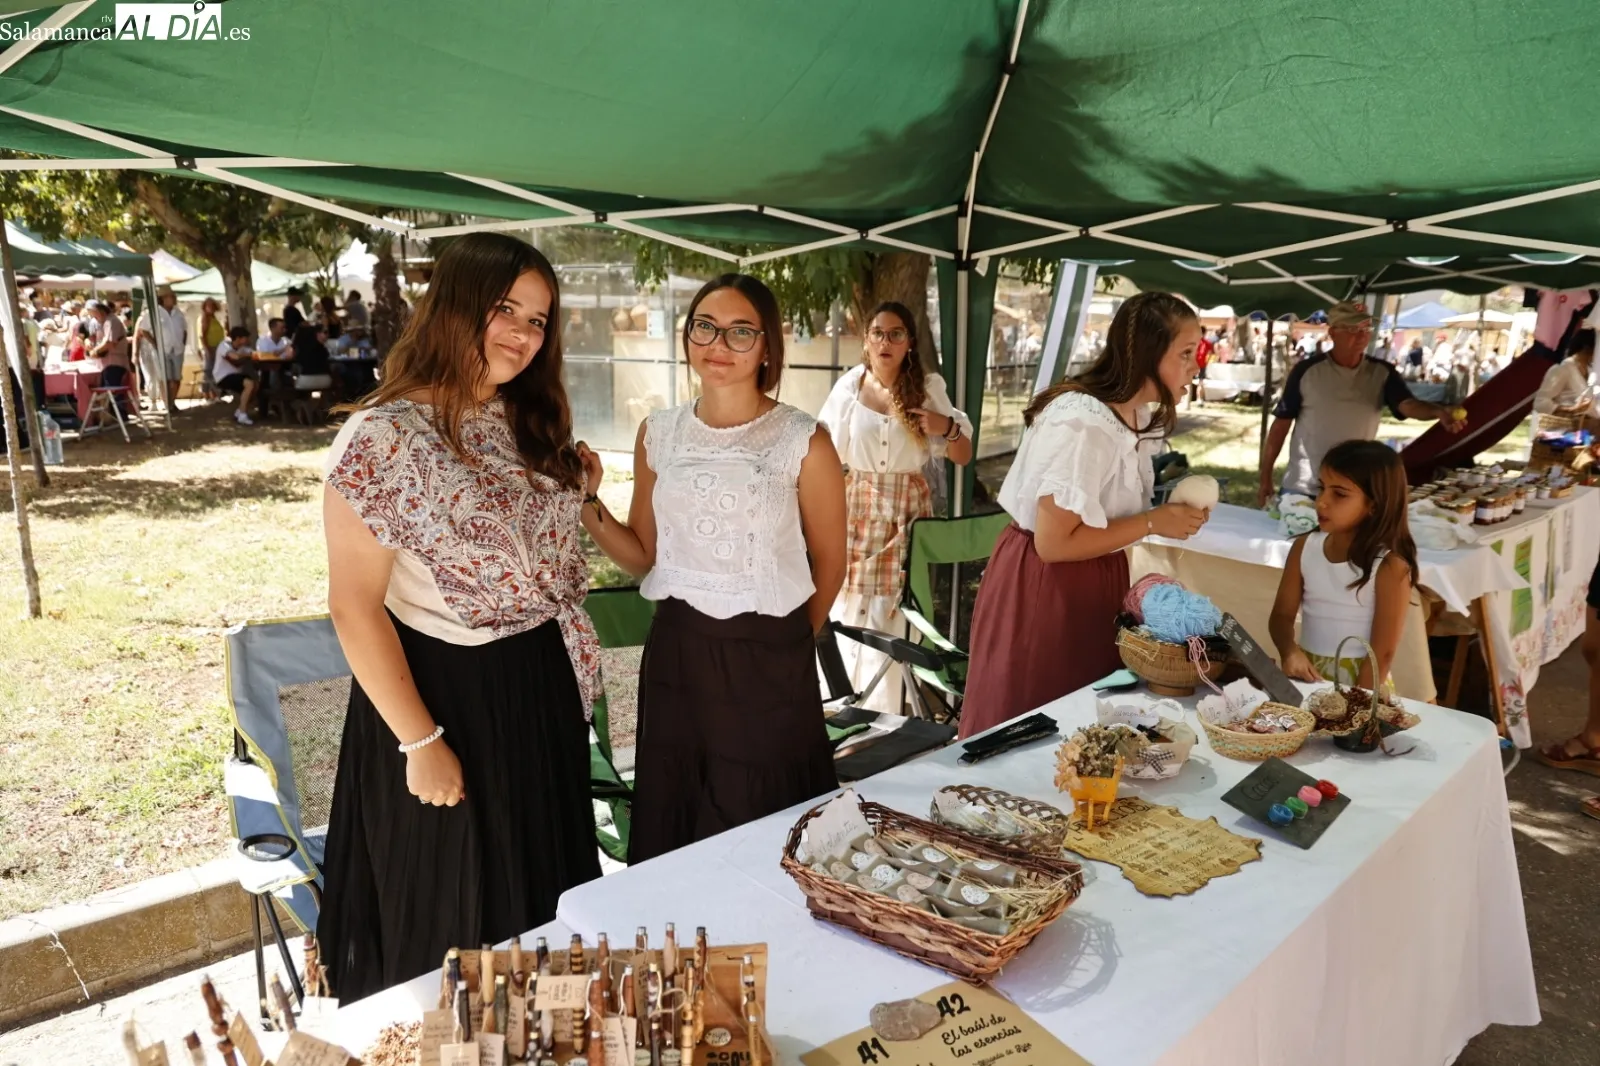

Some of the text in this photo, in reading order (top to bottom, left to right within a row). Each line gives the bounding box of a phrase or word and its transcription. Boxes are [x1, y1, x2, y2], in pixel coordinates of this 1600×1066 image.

[936, 993, 971, 1018] 42
[941, 1013, 1006, 1045] El baúl de
[950, 1025, 1022, 1058] las esencias
[857, 1037, 890, 1065] 41
